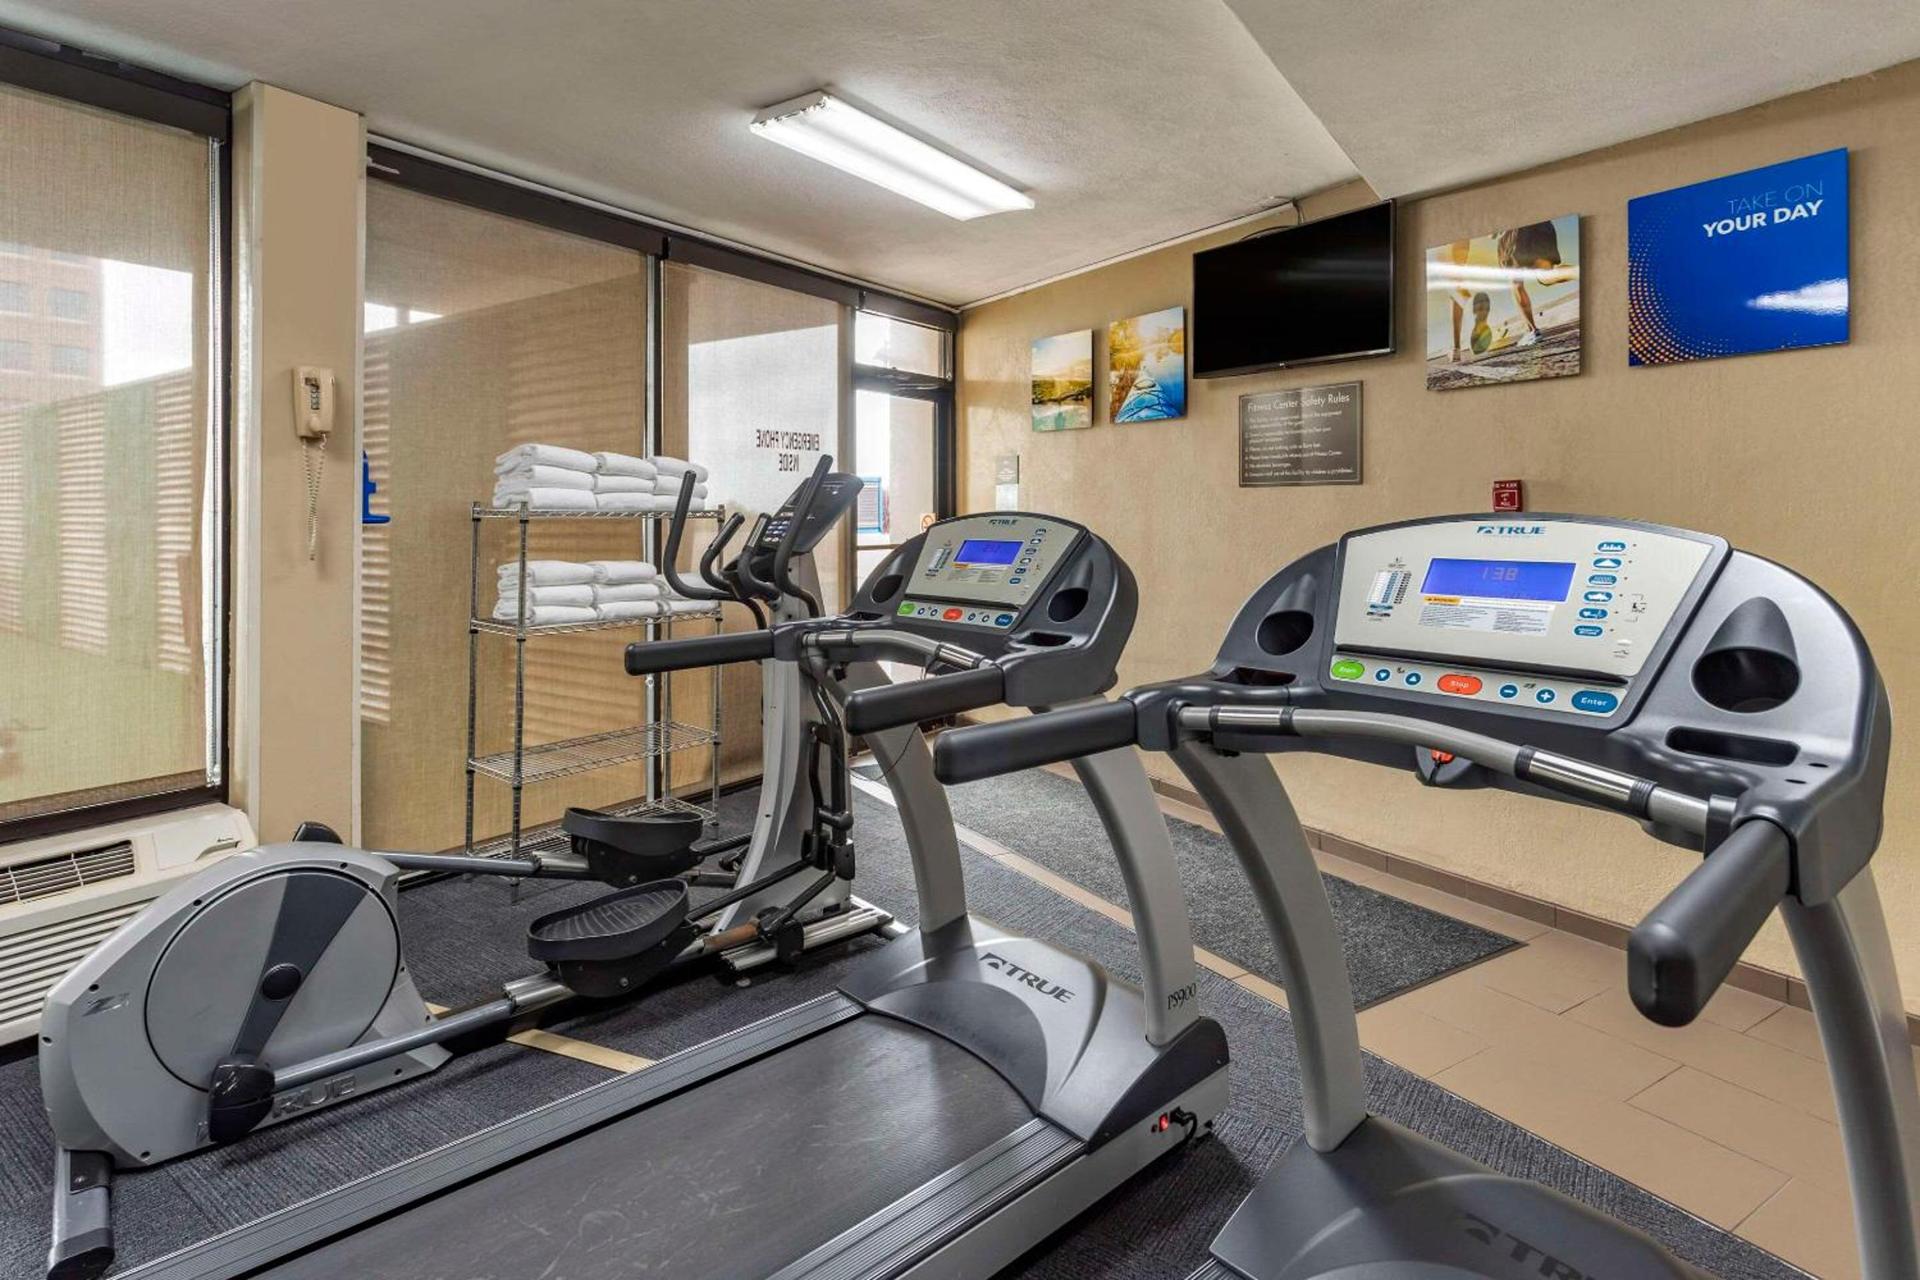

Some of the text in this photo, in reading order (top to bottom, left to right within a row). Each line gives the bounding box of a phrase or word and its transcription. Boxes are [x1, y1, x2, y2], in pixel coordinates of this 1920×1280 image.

[1728, 179, 1824, 215] TAKE ON
[1702, 199, 1824, 238] YOUR DAY
[1273, 399, 1298, 410] Center
[1328, 392, 1350, 404] Rules
[1498, 526, 1545, 534] TRUE
[1451, 680, 1469, 689] Stop
[1581, 697, 1608, 706] Enter
[1005, 963, 1076, 1003] TRUE
[272, 1074, 355, 1118] RUE
